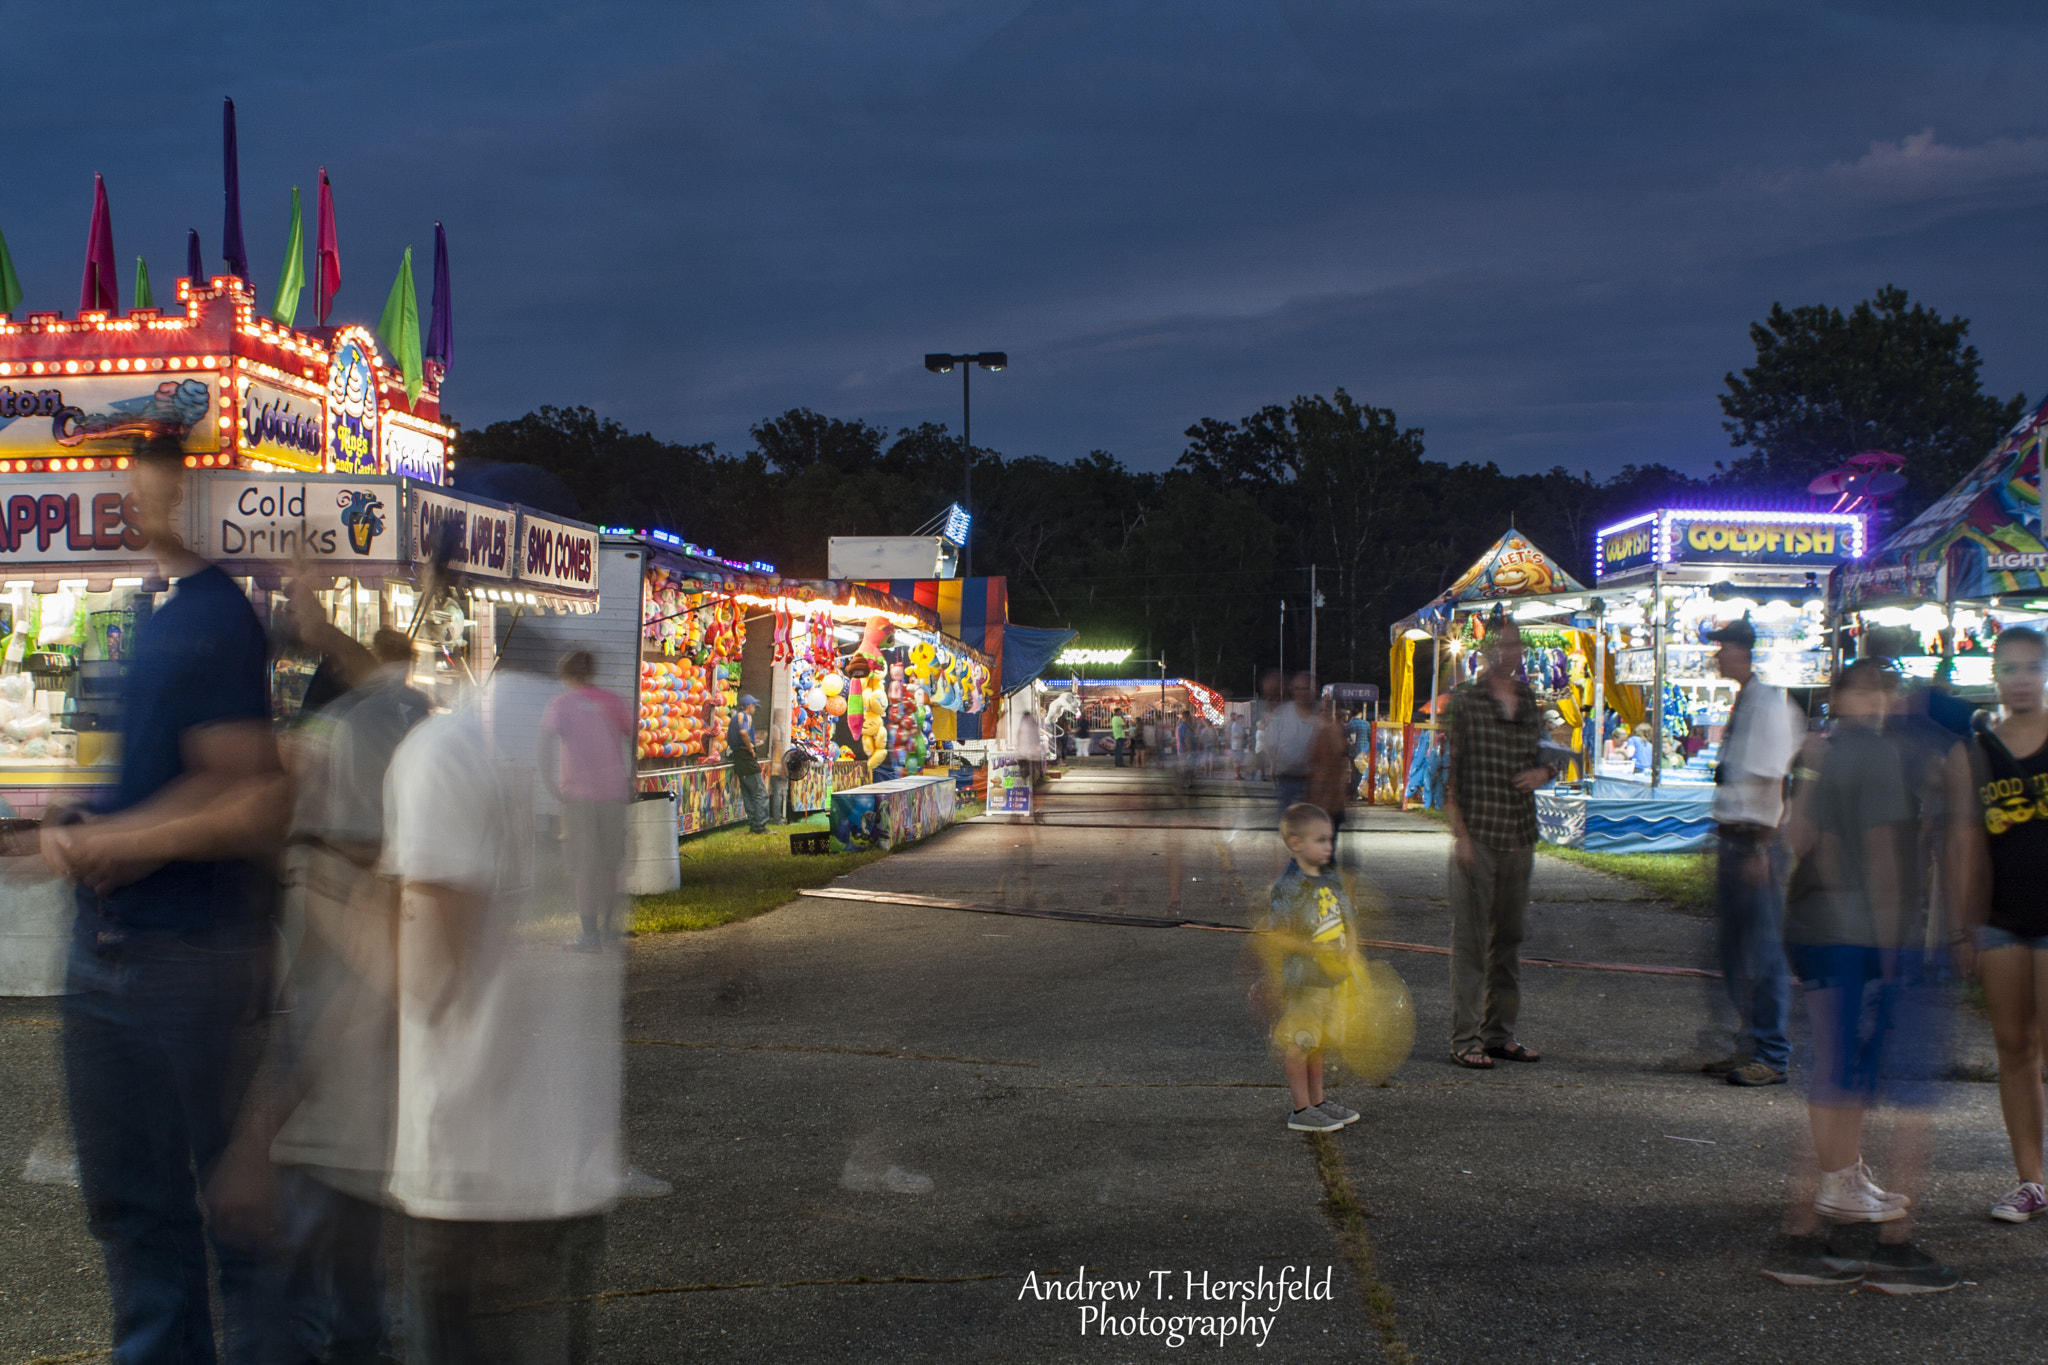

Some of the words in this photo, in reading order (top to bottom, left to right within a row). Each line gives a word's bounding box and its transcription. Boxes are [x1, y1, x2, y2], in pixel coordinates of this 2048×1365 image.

[245, 382, 322, 457] Cotton
[237, 485, 306, 518] Cold
[0, 492, 152, 553] PPLES
[221, 518, 337, 555] Drinks
[1687, 521, 1836, 554] GOLDFISH
[469, 513, 508, 571] APPLES
[526, 525, 553, 577] SNO
[554, 531, 592, 584] CONES
[1499, 549, 1545, 568] LET'S
[1606, 529, 1649, 563] GOLDFISH
[1987, 553, 2048, 572] LIGHT
[681, 579, 721, 590] BUST
[760, 583, 779, 594] TO
[783, 586, 818, 598] WIN
[1482, 587, 1509, 599] GO
[1342, 689, 1371, 697] ENTER
